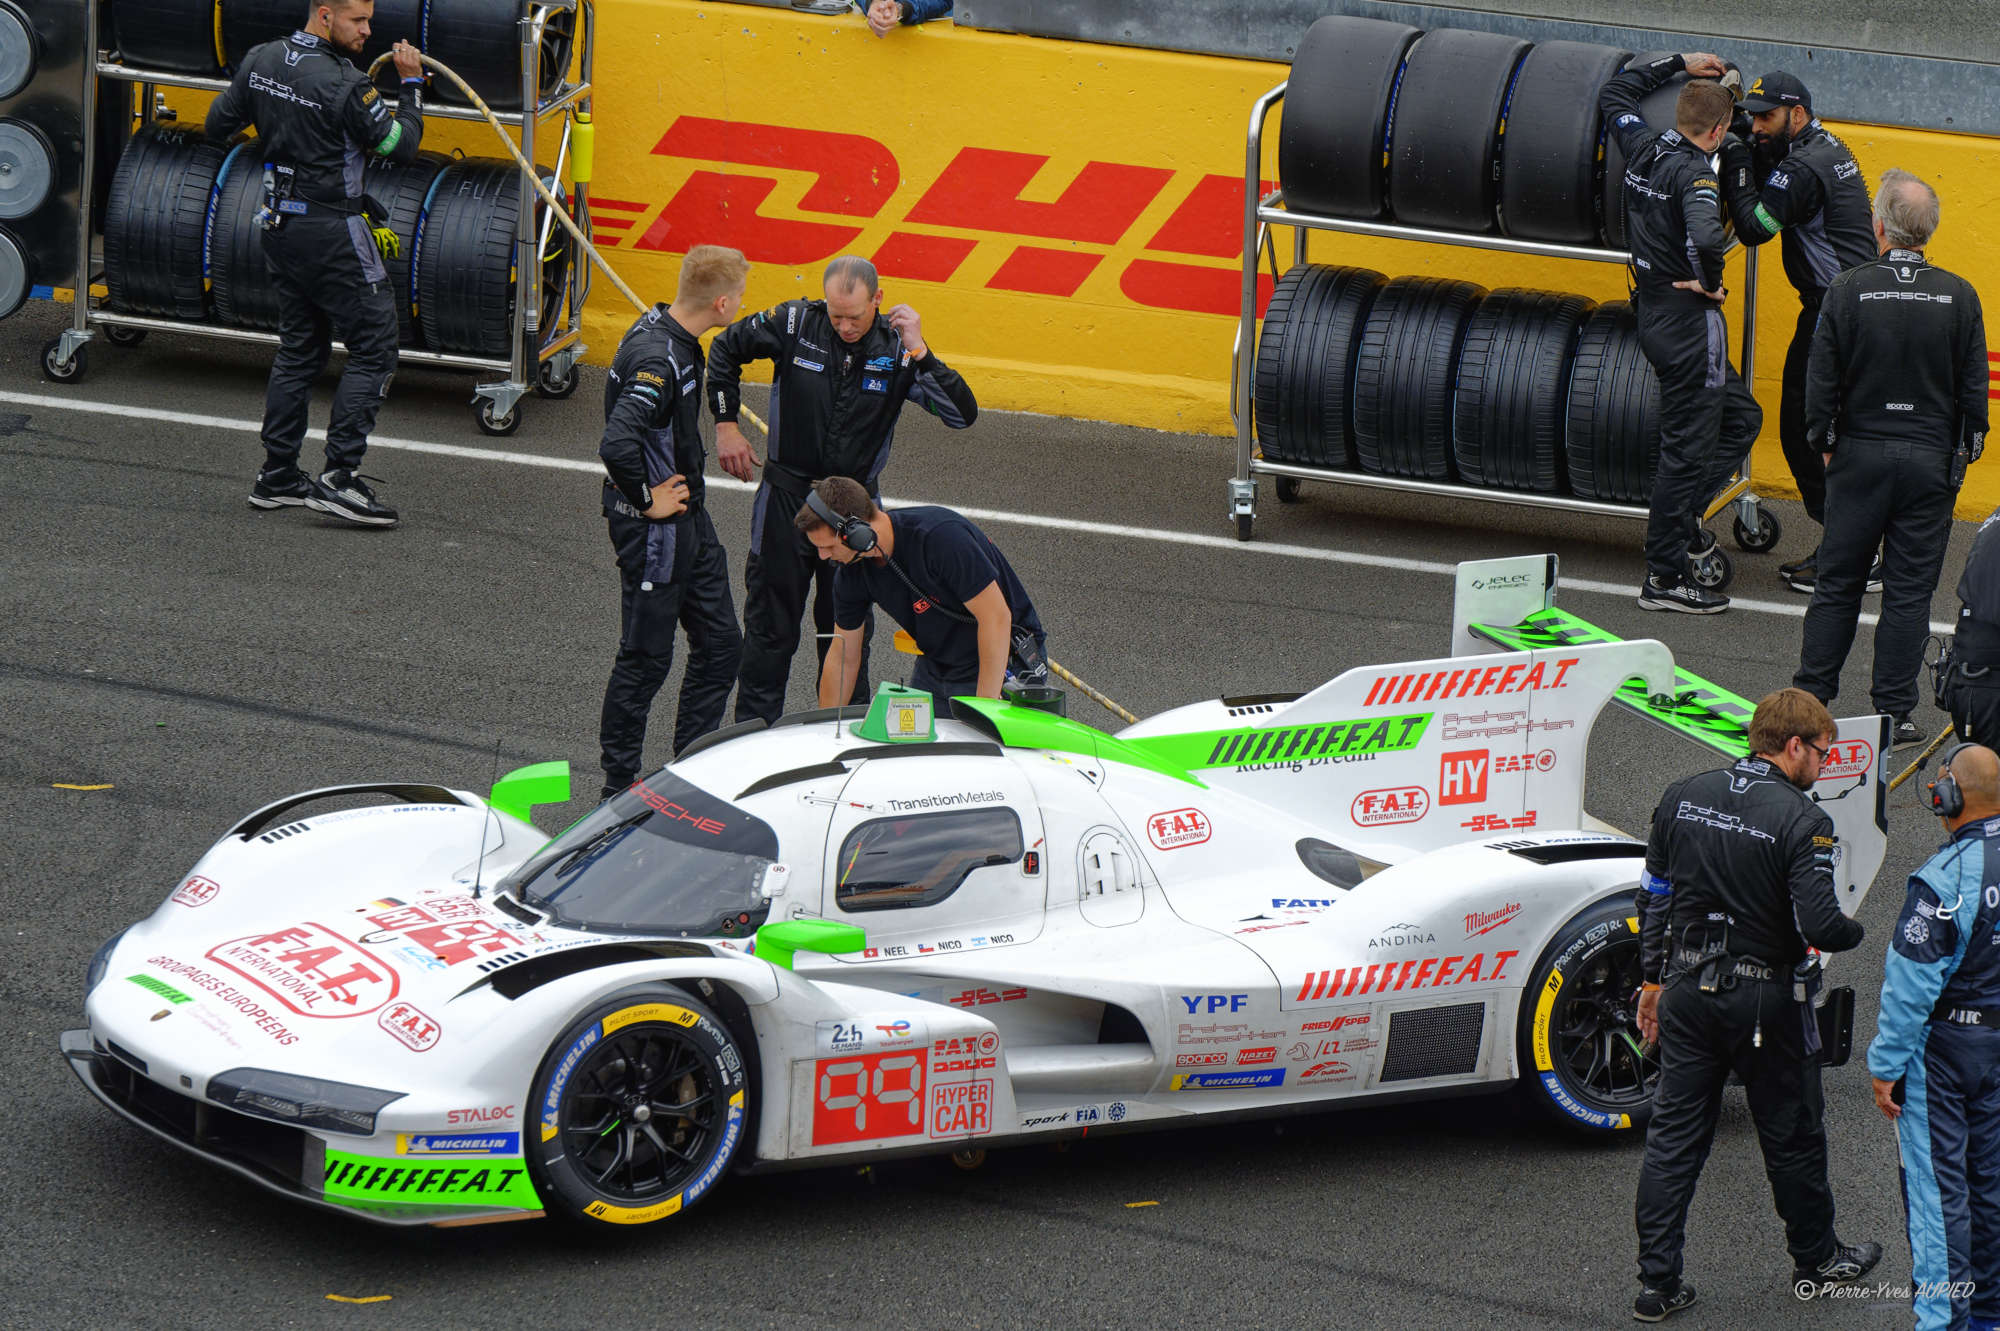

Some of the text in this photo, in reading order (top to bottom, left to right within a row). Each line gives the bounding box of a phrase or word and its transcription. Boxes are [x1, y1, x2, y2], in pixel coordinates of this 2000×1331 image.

[634, 115, 1285, 318] DHL
[1860, 291, 1953, 304] PORSCHE
[1443, 710, 1527, 726] Proton
[1442, 719, 1574, 740] Competition
[1442, 757, 1488, 797] HY
[888, 789, 1005, 813] TransitionMetals
[1362, 810, 1419, 823] INTERNATIONAL
[1680, 800, 1741, 823] Proton
[1676, 809, 1776, 844] Competition
[1160, 830, 1207, 846] INTERNATIONAL
[1463, 902, 1521, 934] Milwaukee
[938, 939, 962, 952] NICO
[991, 933, 1014, 945] NICO
[1368, 932, 1437, 949] ANDINA
[884, 945, 909, 958] NEEL
[227, 945, 324, 1010] INTERNATIONAL
[146, 955, 226, 992] GROUPAGES
[215, 986, 301, 1047] EUROPÉENS
[1181, 994, 1249, 1014] YPF
[678, 1011, 694, 1024] M
[1301, 1015, 1371, 1032] FRIED SPED
[831, 1023, 863, 1043] 24h
[547, 1029, 597, 1110] MICHELIN
[1178, 1054, 1228, 1065] sparco
[1203, 1073, 1273, 1087] MICHELIN
[819, 1054, 922, 1132] 99
[935, 1084, 989, 1105] HYPER
[1543, 1077, 1608, 1127] MICHELIN
[447, 1105, 515, 1124] STALOC
[935, 1104, 988, 1134] CAR
[1021, 1112, 1070, 1127] spark
[431, 1138, 507, 1150] MICHELIN
[689, 1123, 739, 1201] MICHELIN
